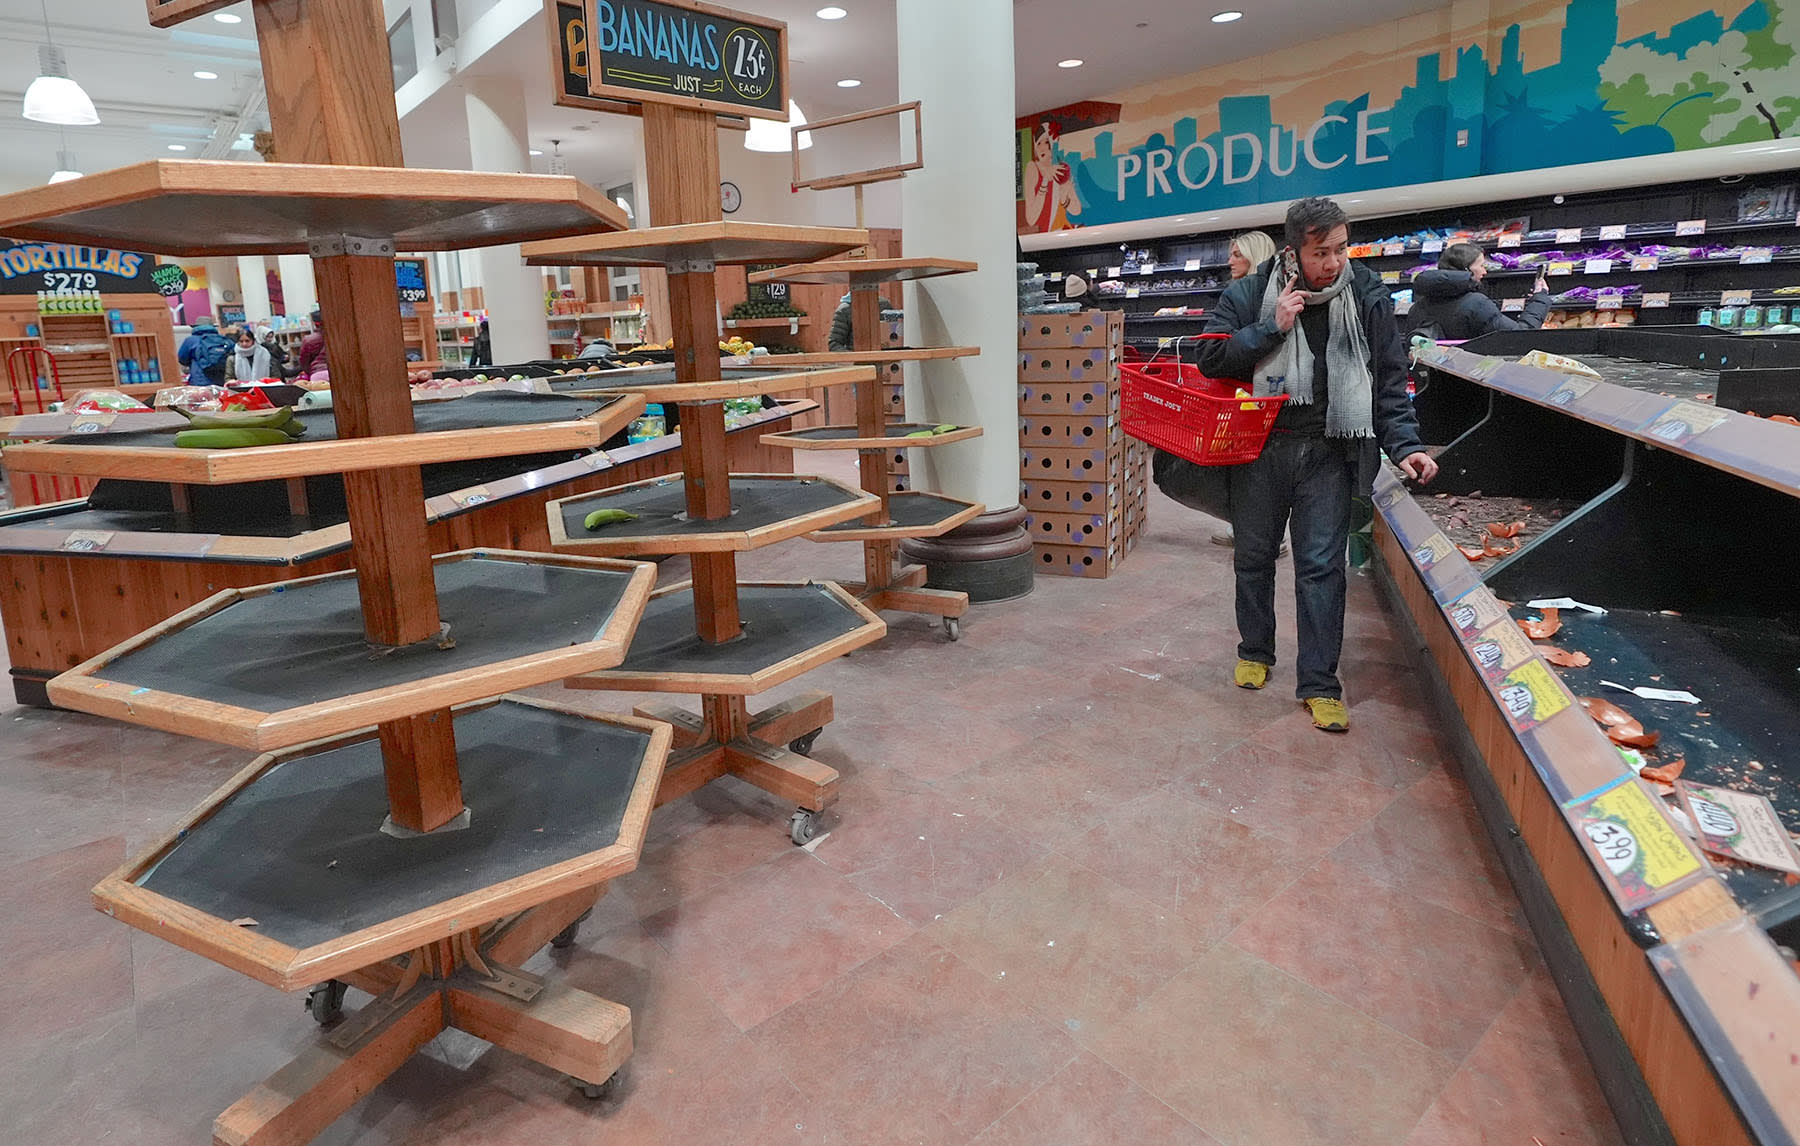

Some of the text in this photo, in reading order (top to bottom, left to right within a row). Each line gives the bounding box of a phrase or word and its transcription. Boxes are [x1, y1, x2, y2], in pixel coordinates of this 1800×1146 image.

[597, 1, 720, 71] BANANAS
[673, 73, 702, 93] JUST
[738, 82, 762, 95] EACH
[1117, 106, 1391, 202] PRODUCE
[0, 244, 143, 279] TORTILLAS
[1143, 392, 1164, 406] TRADER
